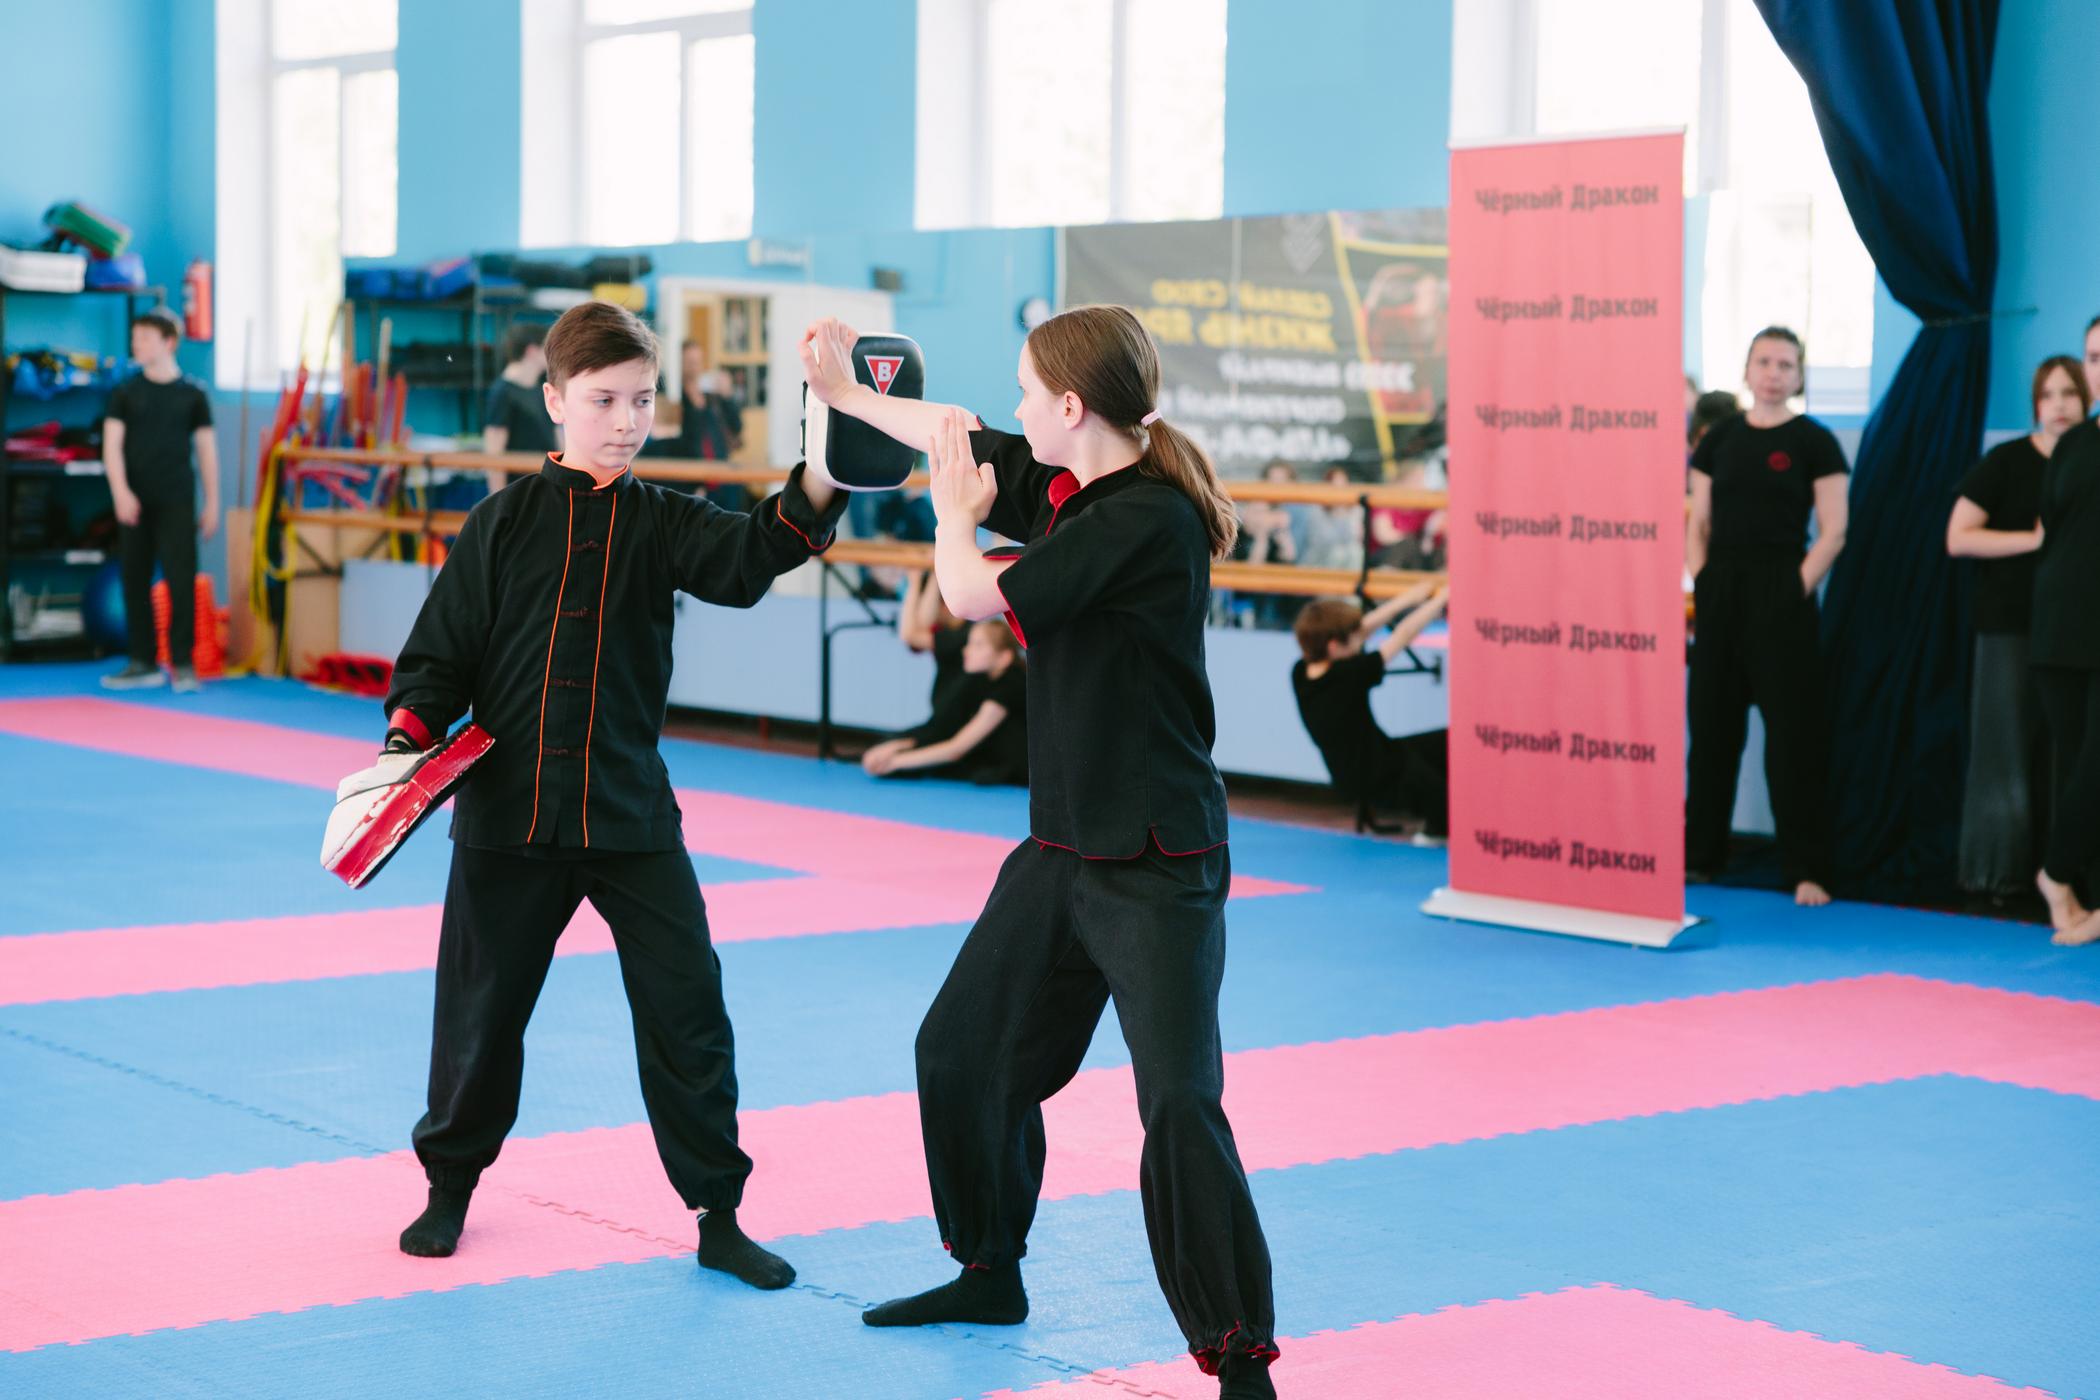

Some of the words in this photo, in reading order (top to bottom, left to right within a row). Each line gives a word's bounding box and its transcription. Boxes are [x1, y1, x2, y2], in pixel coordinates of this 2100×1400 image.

[1476, 187, 1562, 214] Чёрный
[1570, 185, 1658, 211] Дракон
[1476, 296, 1562, 324] Чёрный
[1570, 295, 1657, 321] Дракон
[878, 362, 892, 382] B
[1476, 403, 1562, 433] Чёрный
[1570, 404, 1657, 433] Дракон
[1476, 511, 1562, 539] Чёрный
[1569, 513, 1657, 543] Дракон
[1475, 617, 1562, 647] Чёрный
[1568, 622, 1657, 653] Дракон
[1475, 723, 1562, 754] Чёрный
[1568, 730, 1656, 764] Дракон
[1475, 829, 1562, 862] Чёрный
[1568, 839, 1656, 874] Дракон
